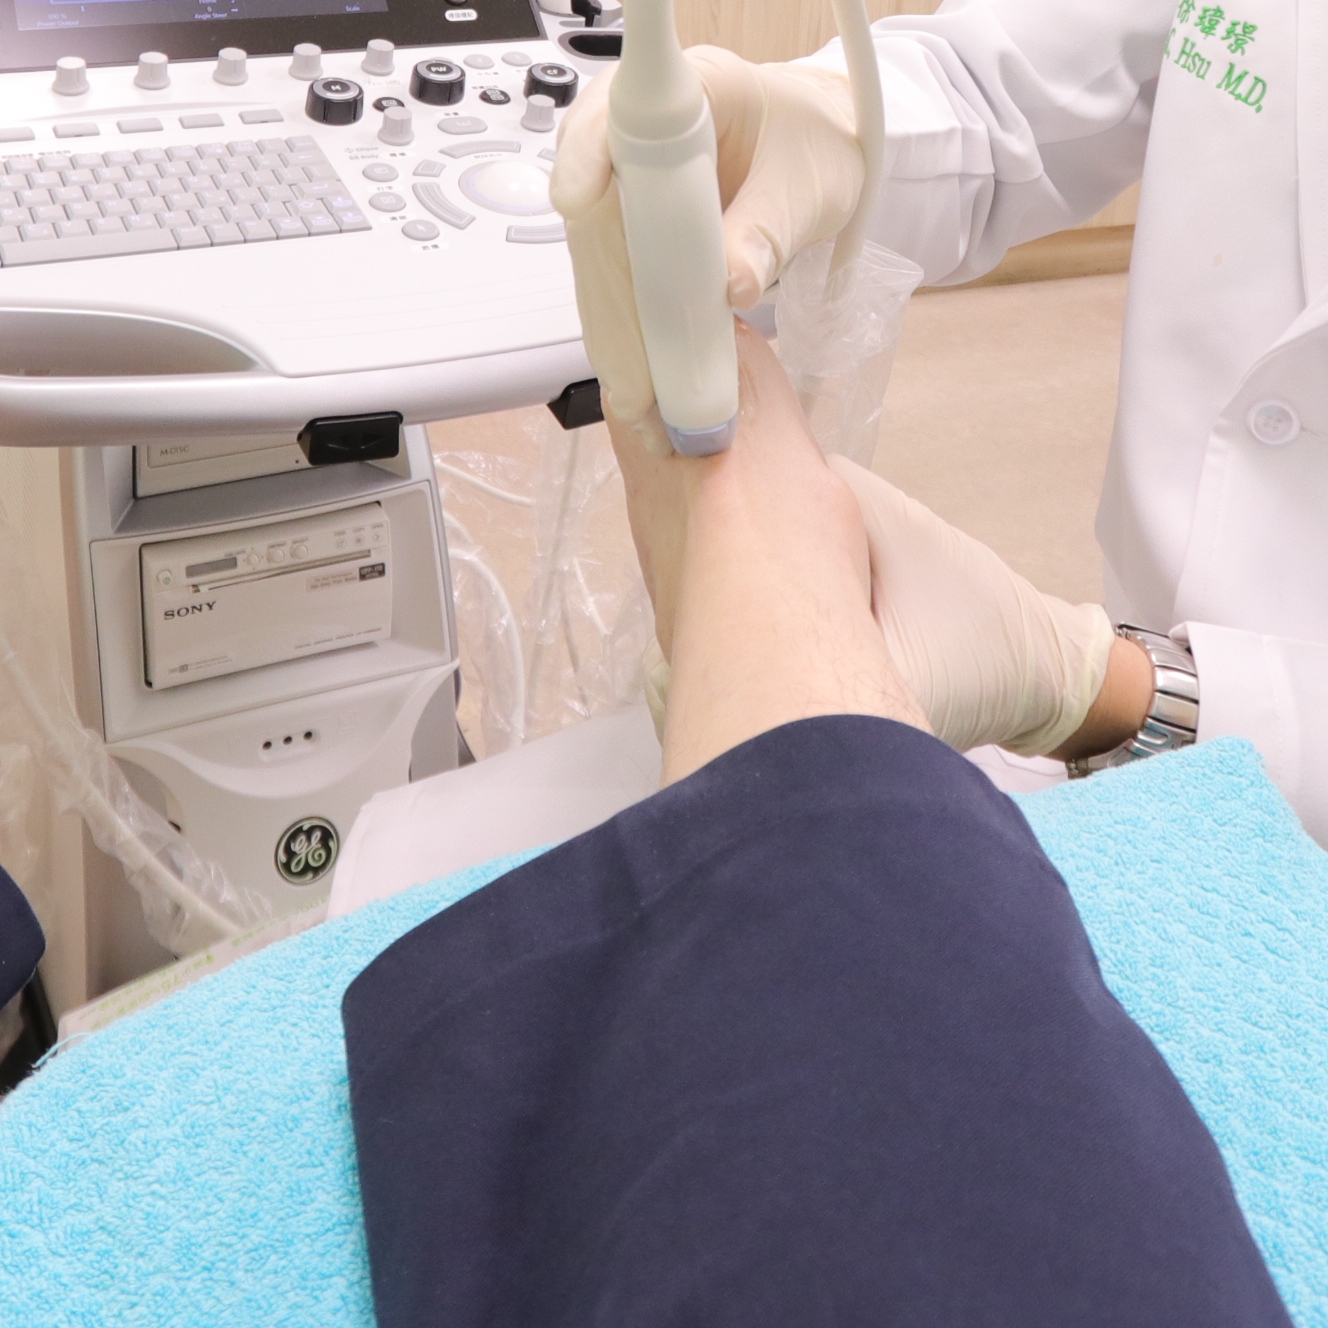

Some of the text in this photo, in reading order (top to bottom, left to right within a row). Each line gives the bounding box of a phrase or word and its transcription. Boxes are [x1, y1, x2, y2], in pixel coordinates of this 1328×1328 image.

[1173, 37, 1212, 80] Hsu
[1215, 62, 1268, 113] M.D.
[164, 601, 217, 620] SONY
